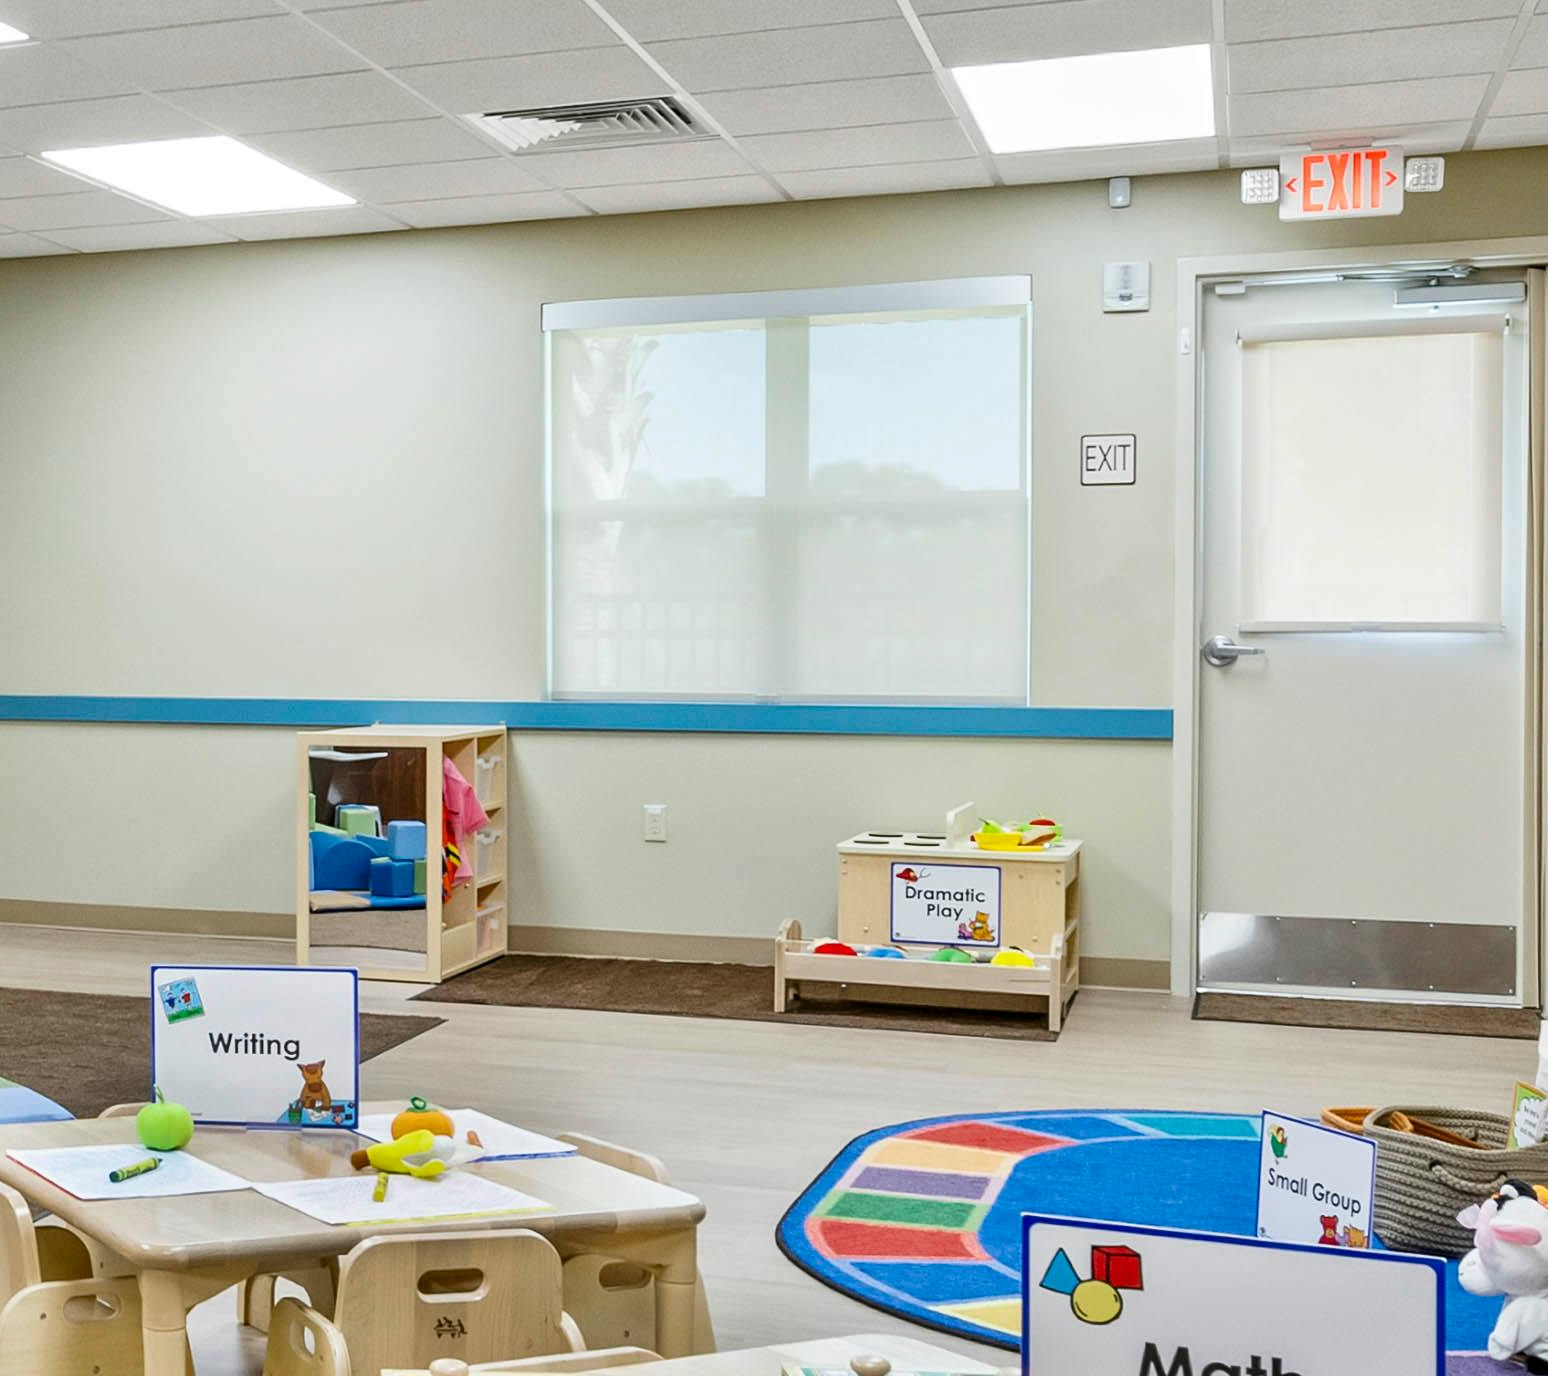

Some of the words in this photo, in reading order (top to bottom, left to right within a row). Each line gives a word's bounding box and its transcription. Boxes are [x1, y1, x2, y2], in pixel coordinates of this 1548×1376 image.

[1302, 150, 1389, 213] EXIT
[1085, 444, 1130, 472] EXIT
[905, 884, 986, 903] Dramatic
[926, 902, 963, 922] Play
[208, 1032, 301, 1061] Writing
[1267, 1167, 1309, 1197] Small
[1312, 1182, 1362, 1217] Group
